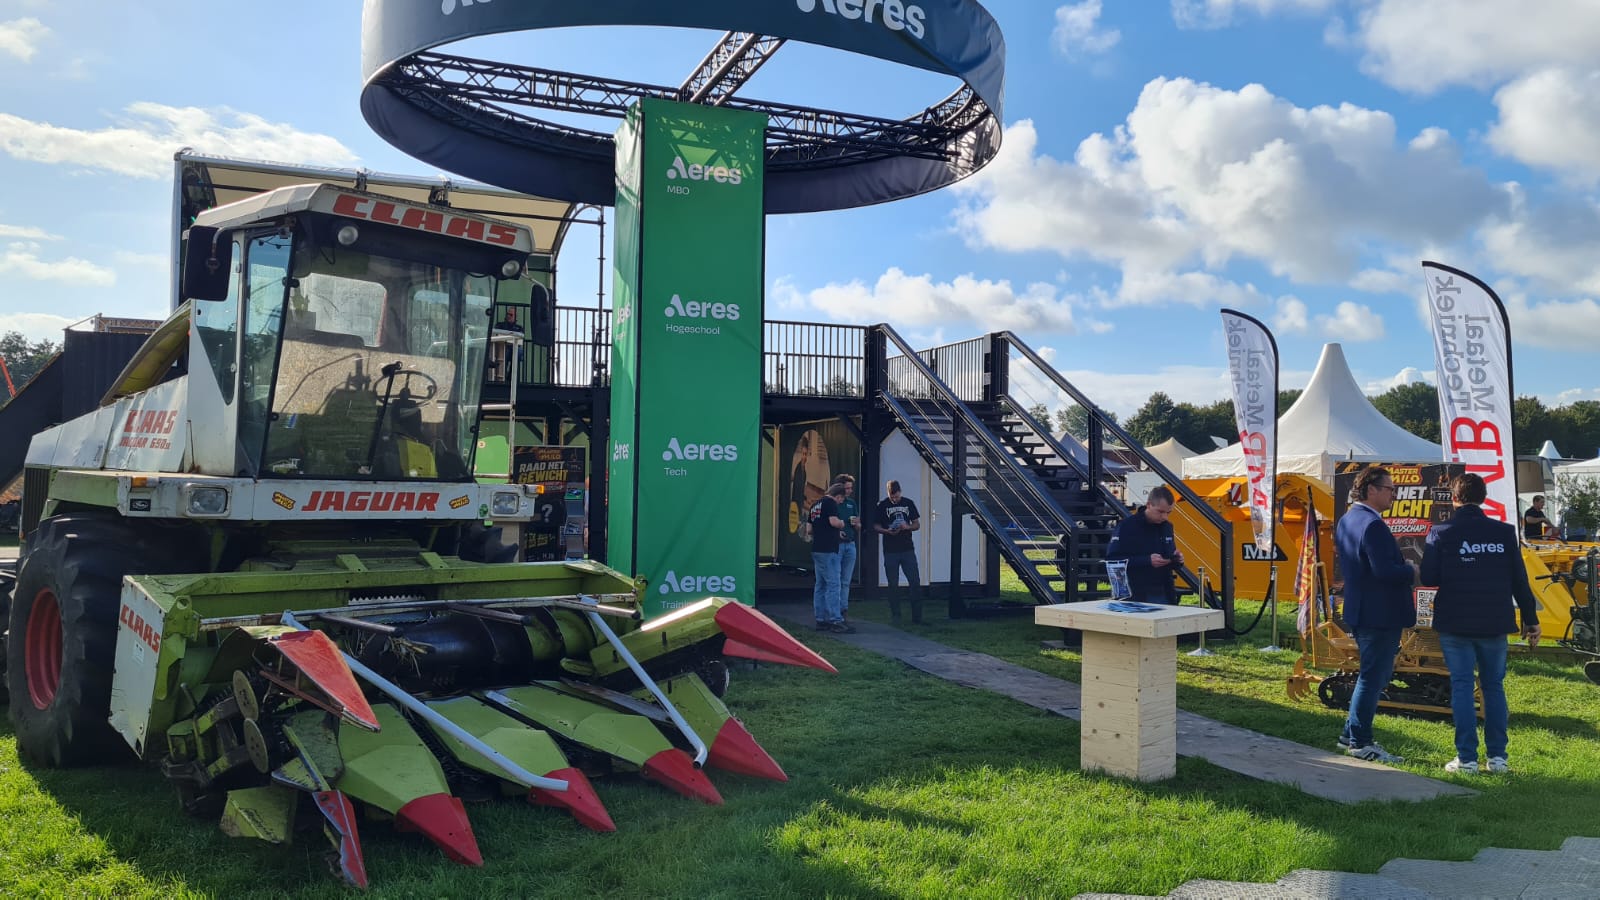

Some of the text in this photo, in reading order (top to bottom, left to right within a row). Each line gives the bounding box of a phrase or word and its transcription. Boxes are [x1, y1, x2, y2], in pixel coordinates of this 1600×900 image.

[667, 156, 742, 185] Aeres
[667, 185, 690, 195] MBO
[332, 194, 518, 246] CLAAS
[664, 294, 740, 320] Aeres
[665, 323, 720, 335] Hogeschool
[124, 410, 178, 434] CLAAS
[662, 437, 738, 461] Aeres
[517, 470, 568, 484] GEWICHT
[519, 463, 546, 473] RAAD
[663, 467, 687, 476] Tech
[301, 491, 440, 511] JAGUAR
[1396, 486, 1428, 499] HET
[1459, 541, 1505, 554] Aeres
[659, 570, 736, 595] Aeres
[120, 604, 160, 653] CLAAS
